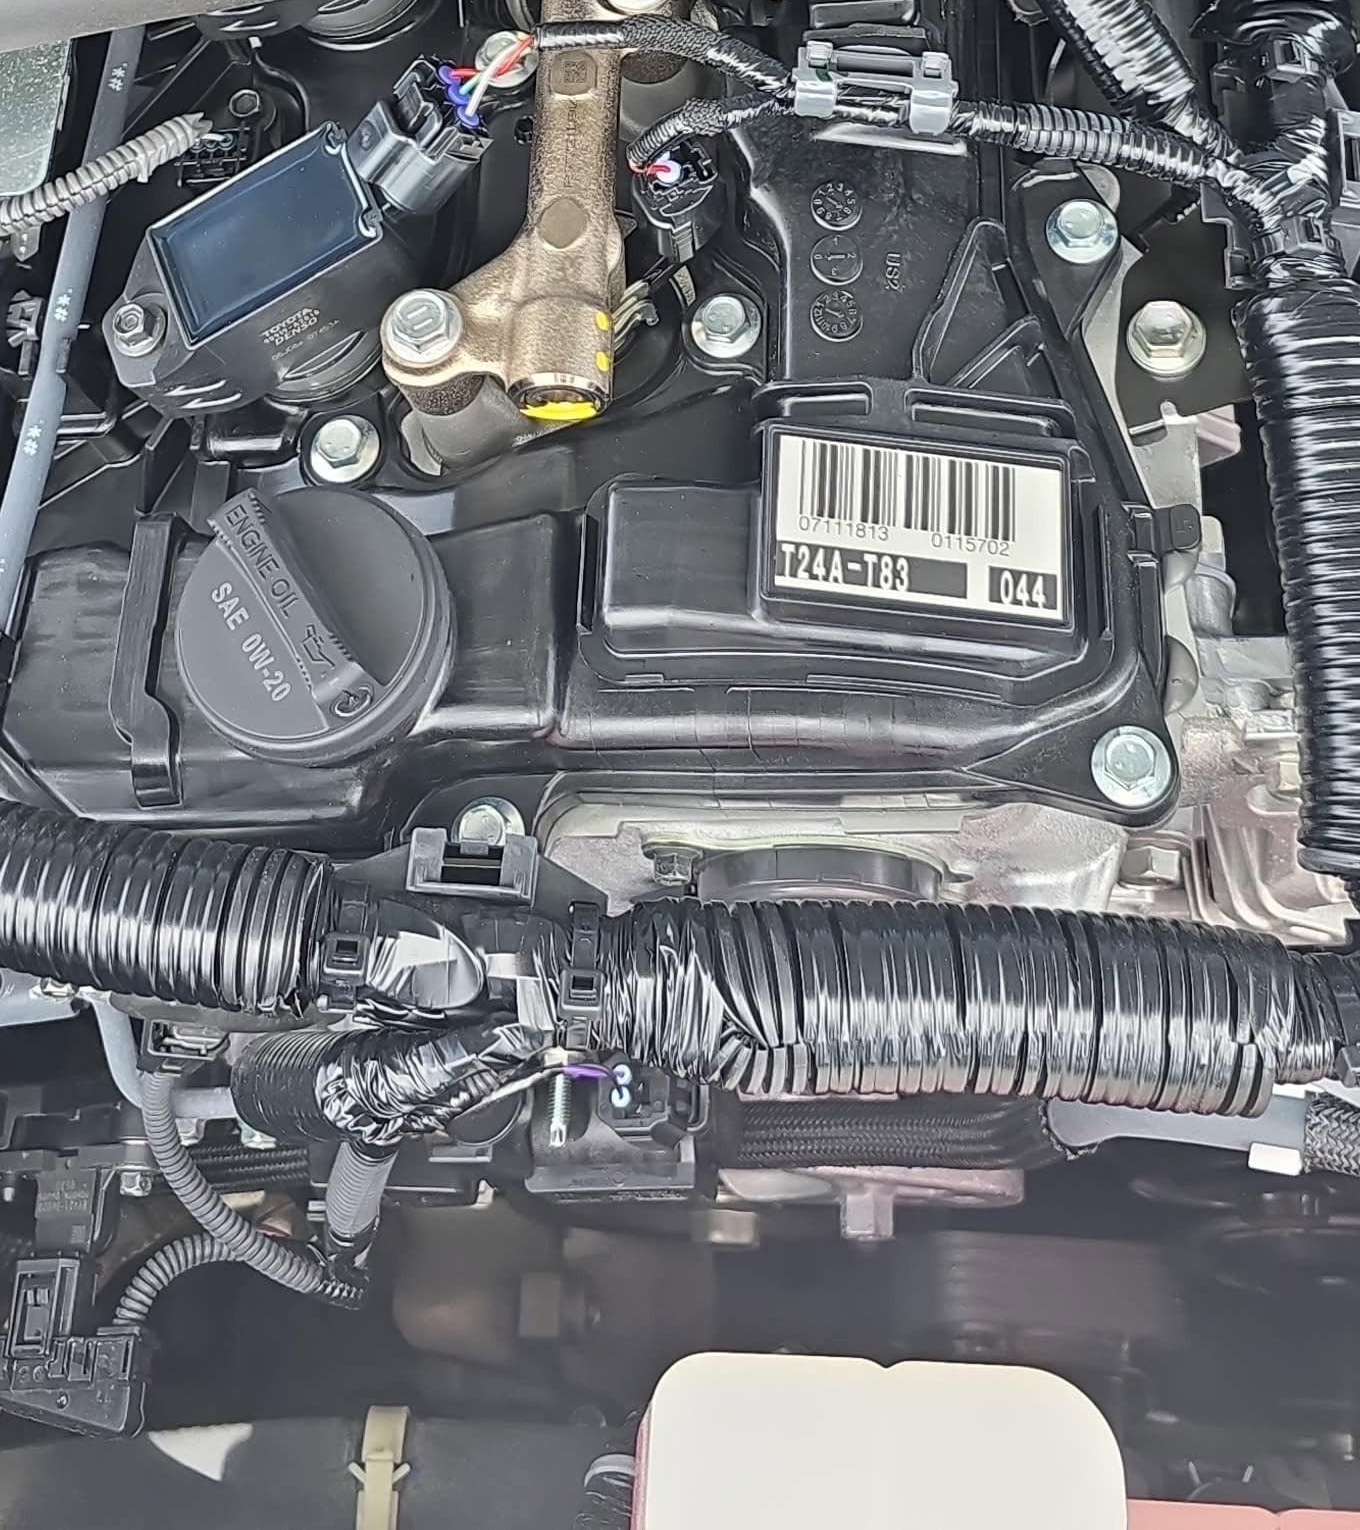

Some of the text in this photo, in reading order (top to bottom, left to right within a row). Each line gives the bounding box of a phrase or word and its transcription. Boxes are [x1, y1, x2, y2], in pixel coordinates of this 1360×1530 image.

[260, 308, 313, 338] TOYOTA
[275, 316, 318, 347] DENSO
[798, 515, 889, 542] 07111813
[931, 532, 1010, 557] 0115702
[225, 503, 299, 619] ENGINE OIL
[781, 543, 1047, 609] T24A-T83 044
[212, 582, 291, 702] SAE 0W-20
